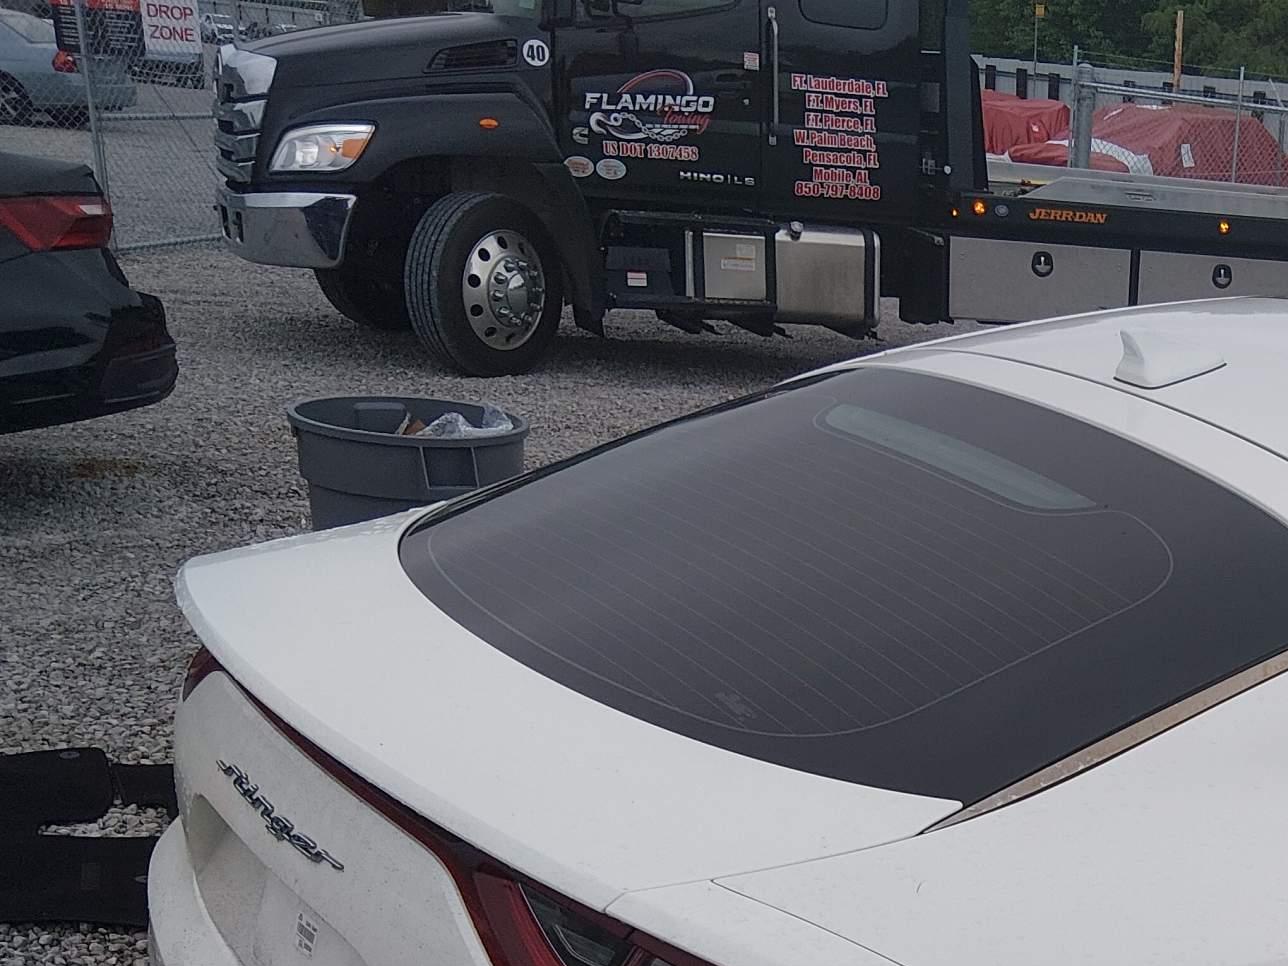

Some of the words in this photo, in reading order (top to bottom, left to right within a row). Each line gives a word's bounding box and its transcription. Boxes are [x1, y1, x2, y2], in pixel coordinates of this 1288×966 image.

[146, 3, 194, 21] DROP
[149, 24, 196, 42] ZONE
[526, 44, 546, 63] 40
[808, 75, 875, 96] Lauderdale,
[875, 81, 889, 97] FL
[584, 92, 715, 113] FLAMINGO
[824, 94, 862, 114] Myers,
[862, 98, 876, 114] FL
[656, 105, 712, 135] Towing
[822, 114, 863, 133] Pierce,
[863, 117, 876, 132] FL
[602, 140, 619, 157] US
[619, 141, 646, 158] DOT
[646, 143, 700, 161] 1307458
[808, 131, 838, 148] Palm
[839, 133, 876, 151] Beach,
[804, 149, 866, 168] Pensacola,
[866, 153, 880, 169] FL
[679, 170, 725, 183] HINO
[814, 167, 855, 184] Mobile,
[855, 170, 869, 185] AL
[796, 182, 880, 199] 850-797-8408
